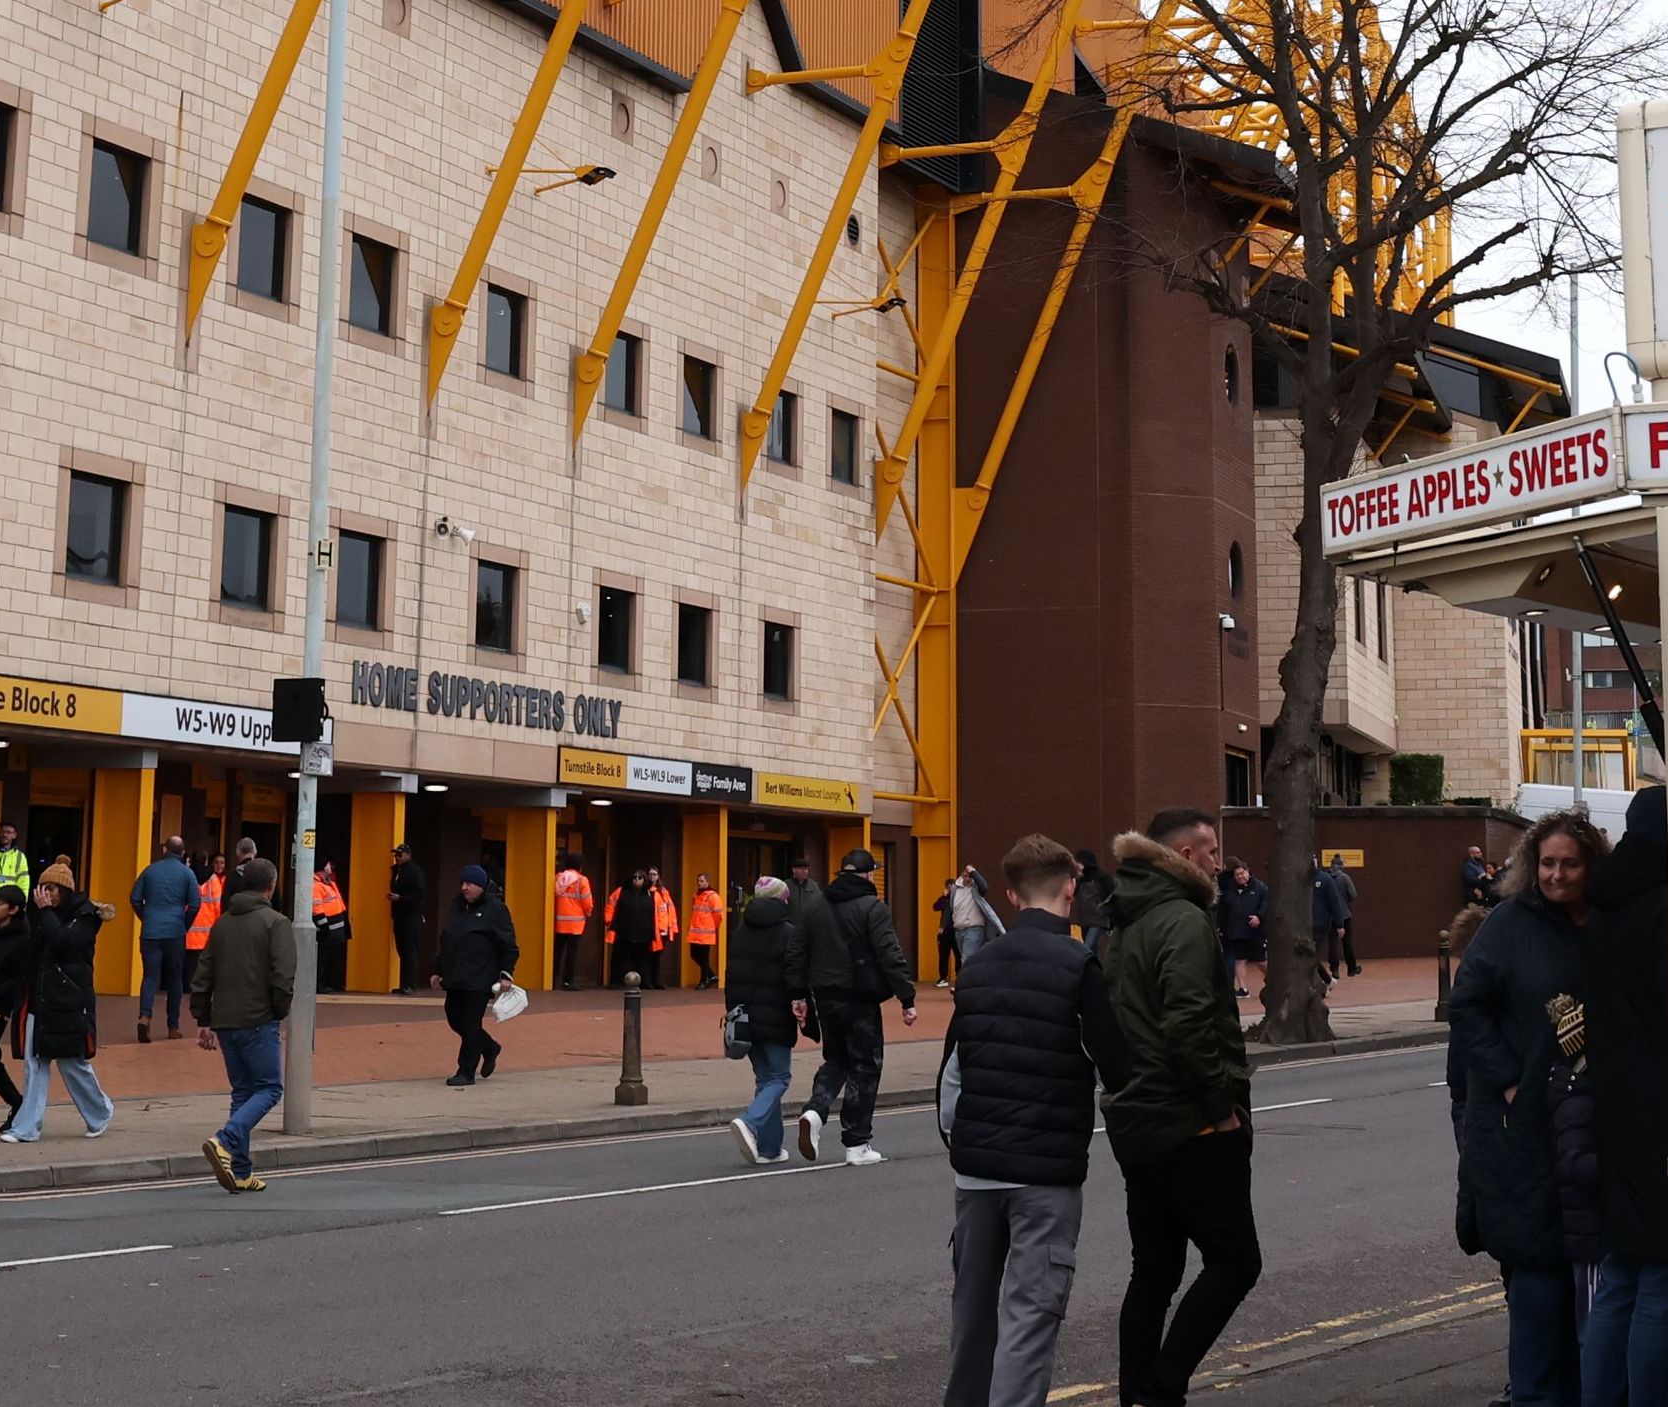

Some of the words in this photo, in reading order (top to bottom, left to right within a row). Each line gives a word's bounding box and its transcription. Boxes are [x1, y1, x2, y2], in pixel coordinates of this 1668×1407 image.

[1328, 482, 1399, 538] TOFFEE
[1407, 459, 1491, 521] APPLES
[1509, 428, 1608, 497] SWEETS
[12, 688, 61, 717] Block
[65, 697, 77, 718] 8
[351, 660, 417, 712] HOME
[427, 670, 565, 732] SUPPORTERS
[573, 695, 622, 739] ONLY
[175, 707, 235, 737] W5-W9
[241, 713, 272, 745] Upp
[564, 758, 594, 776] Turnstile
[596, 764, 615, 777] Block
[616, 766, 621, 777] 8
[633, 766, 665, 783] WL5-WL9
[666, 771, 686, 785] Lower
[713, 775, 732, 793] Family
[732, 778, 747, 792] Area
[765, 782, 777, 794] Bert
[778, 783, 803, 797] Williams
[822, 788, 841, 803] Lounge
